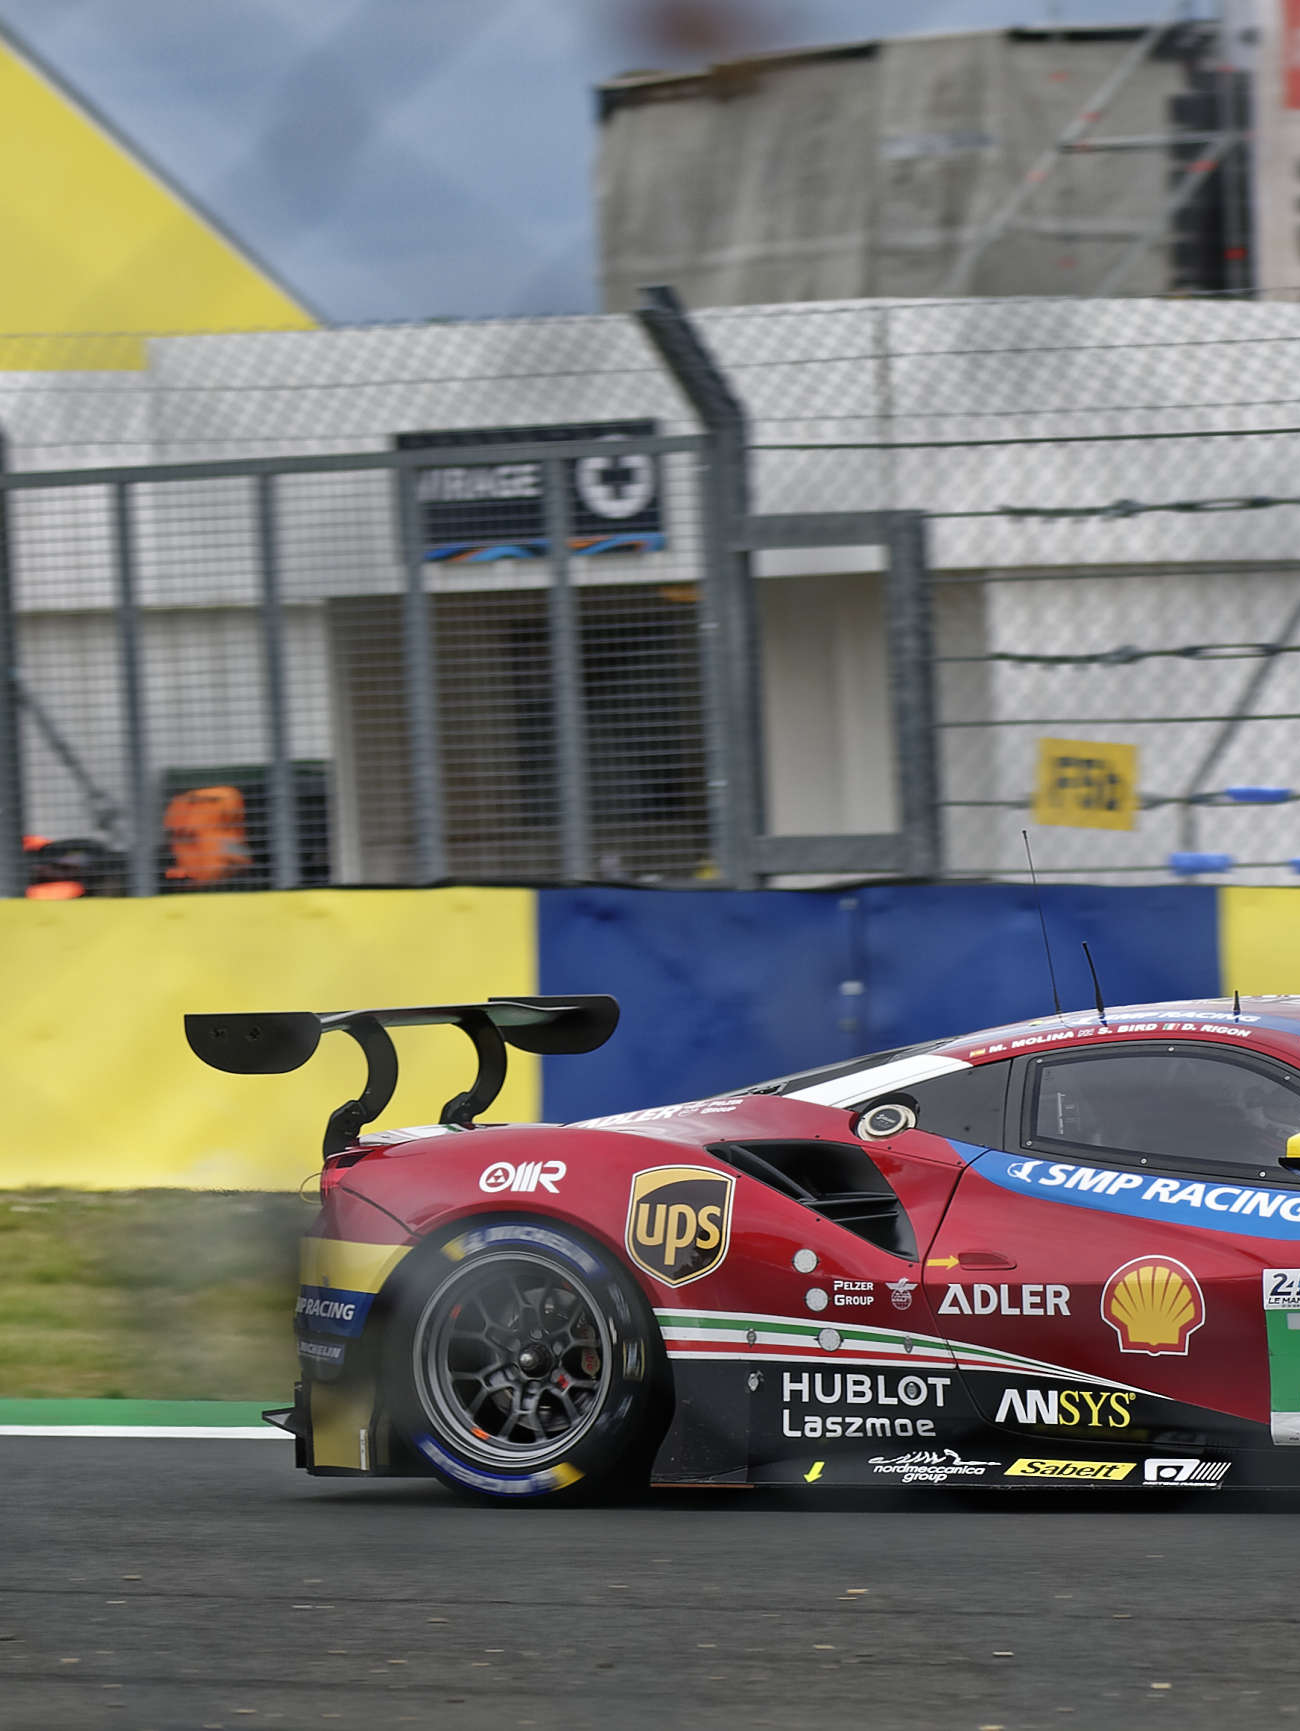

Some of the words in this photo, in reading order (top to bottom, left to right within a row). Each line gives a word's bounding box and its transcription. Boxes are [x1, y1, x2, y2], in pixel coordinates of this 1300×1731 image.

[1159, 1011, 1261, 1023] RACING
[989, 1044, 1008, 1054] M.
[1012, 1031, 1075, 1049] MOLINA
[1097, 1026, 1114, 1036] S.
[1117, 1023, 1158, 1034] BIRD
[1181, 1023, 1198, 1032] D.
[1201, 1024, 1253, 1038] RIGON
[1037, 1162, 1144, 1200] SMP
[636, 1201, 721, 1265] ups
[306, 1299, 356, 1320] RACING
[937, 1284, 1071, 1316] ADLER
[1268, 1296, 1281, 1305] LE
[783, 1372, 951, 1407] HUBLOT
[995, 1389, 1132, 1428] ANSYS
[873, 1463, 986, 1475] nordmeccanica
[901, 1472, 948, 1483] group
[1021, 1461, 1119, 1478] Sabelt
